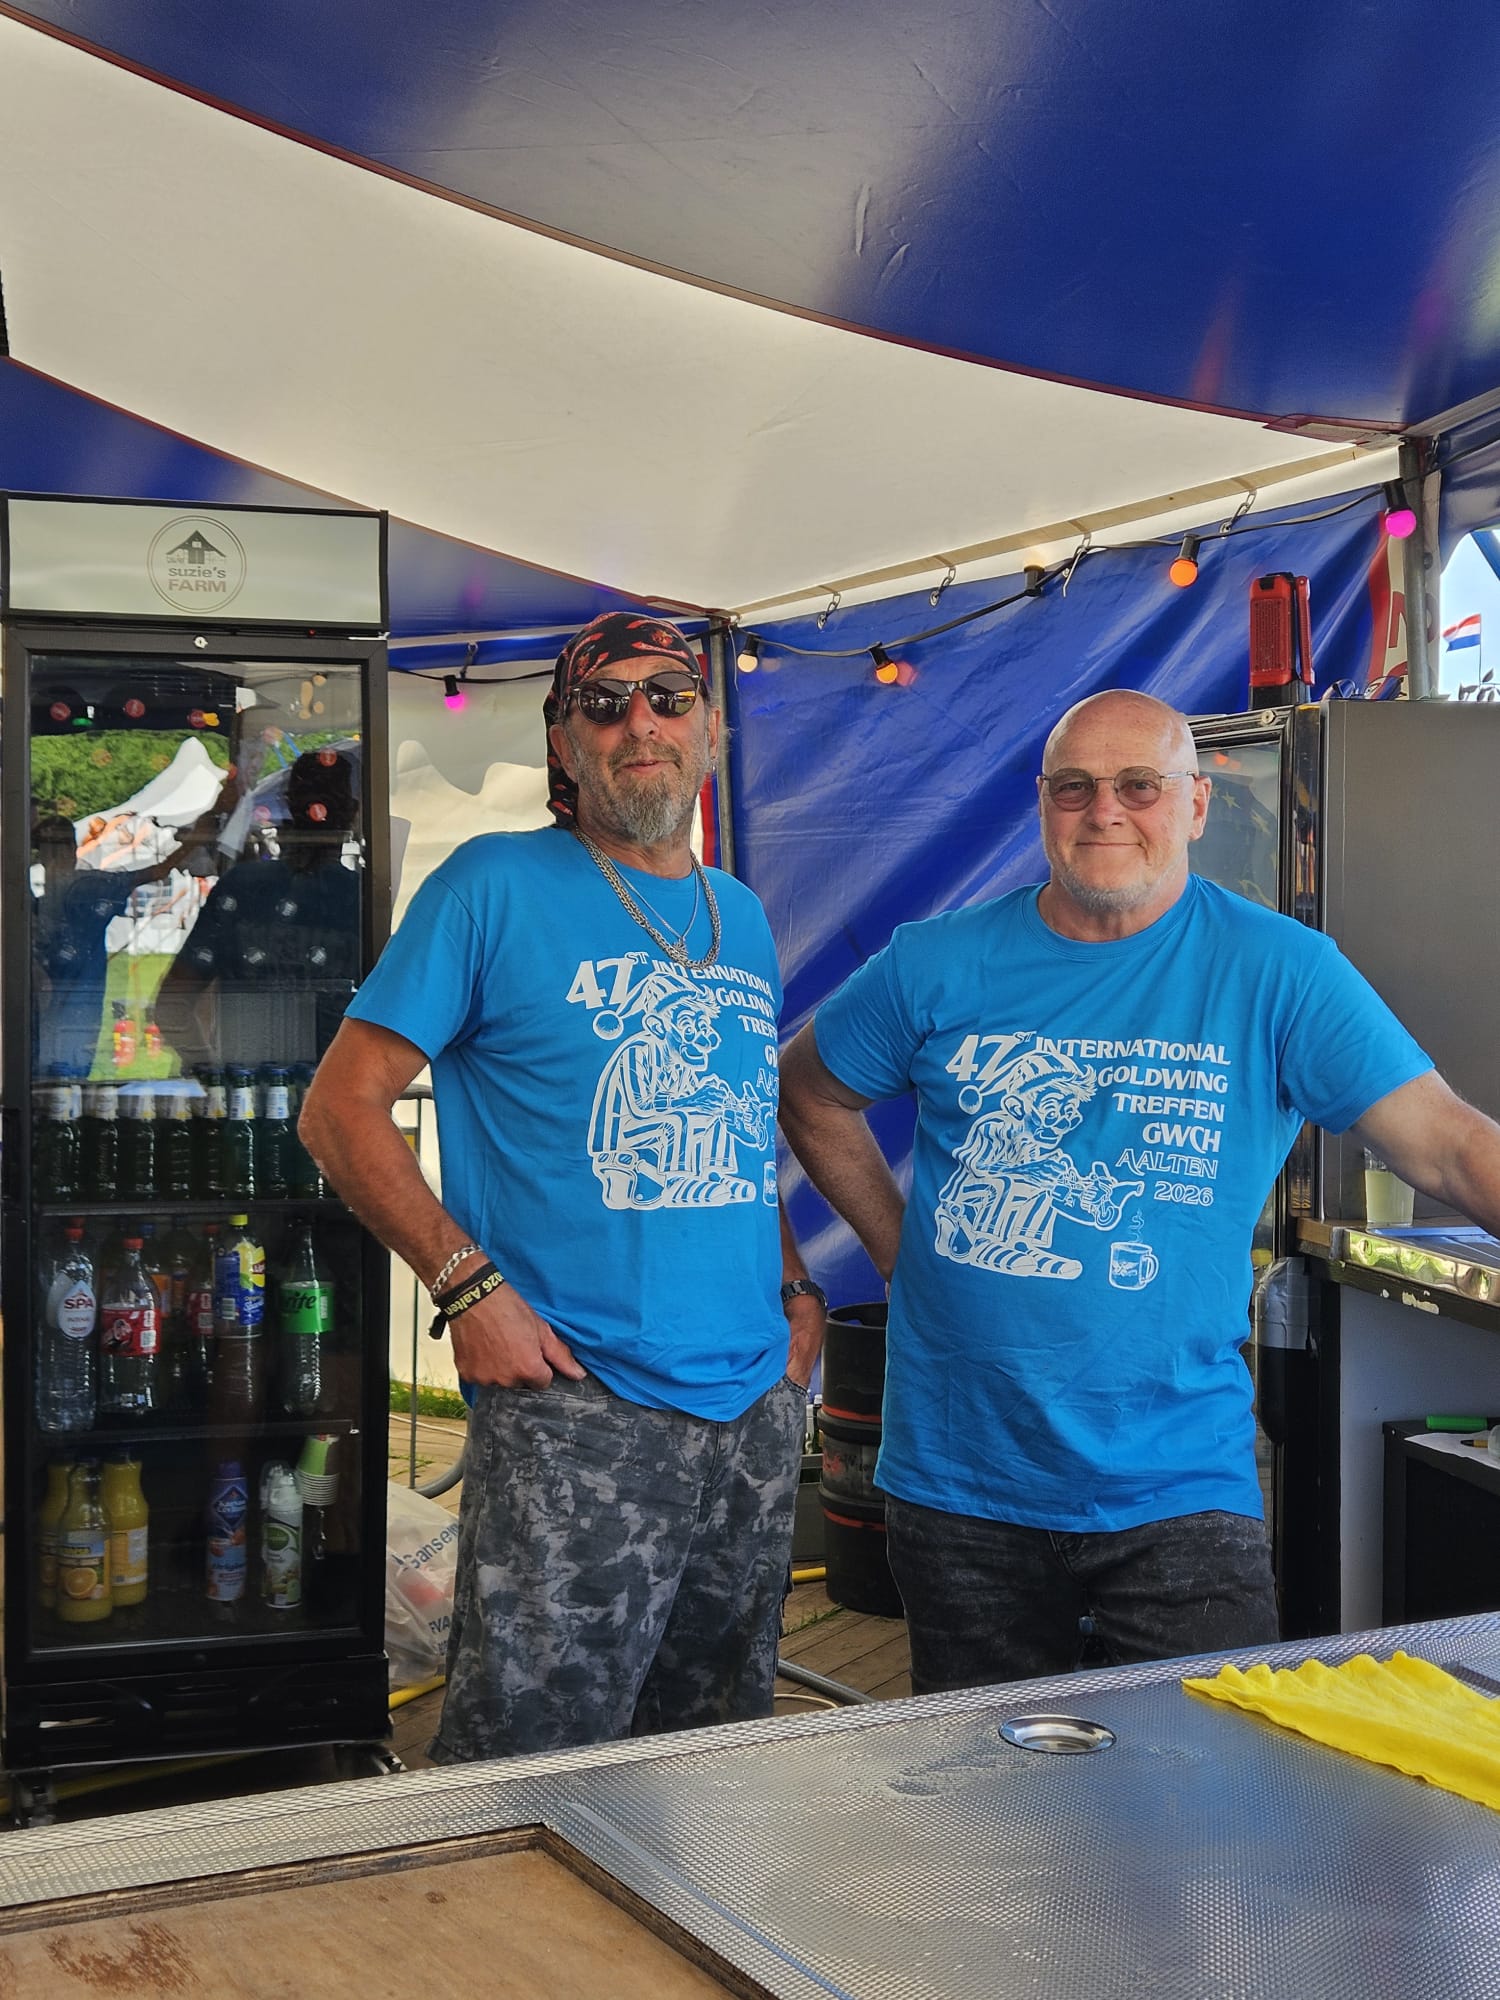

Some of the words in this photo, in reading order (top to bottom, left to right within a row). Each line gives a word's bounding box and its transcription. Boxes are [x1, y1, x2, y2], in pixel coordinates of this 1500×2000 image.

[168, 566, 227, 578] suzie's
[168, 579, 227, 593] FARM
[651, 960, 776, 1004] INTERNATIONA
[1033, 1036, 1232, 1066] INTERNATIONAL
[1098, 1065, 1229, 1094] GOLDWING
[1111, 1092, 1226, 1123] TREFFEN
[1142, 1121, 1222, 1154] GWCH
[1115, 1148, 1219, 1180] AALTEN
[1153, 1181, 1215, 1207] 2026
[481, 1271, 505, 1293] 026
[64, 1298, 94, 1309] SPA
[443, 1286, 481, 1316] Aalten
